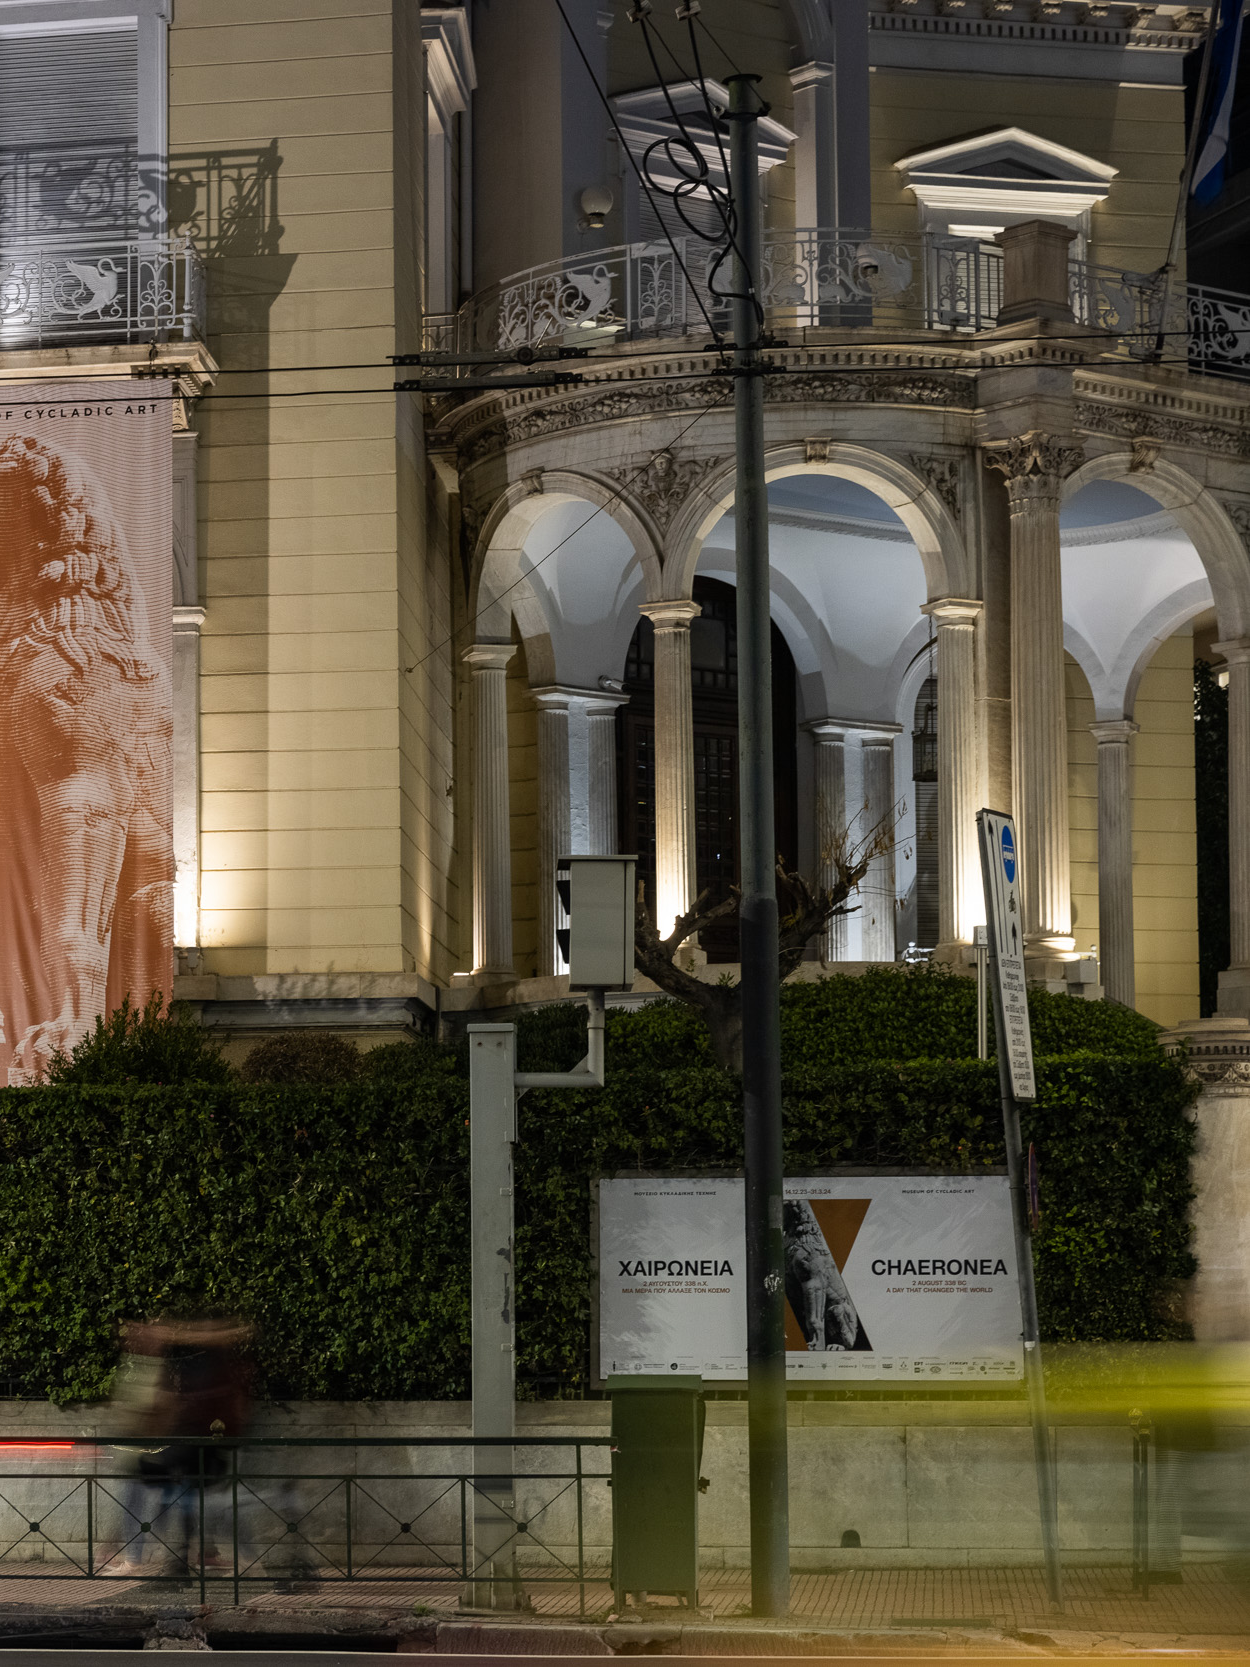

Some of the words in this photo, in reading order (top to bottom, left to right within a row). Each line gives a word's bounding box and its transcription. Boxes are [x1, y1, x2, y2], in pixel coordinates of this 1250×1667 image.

[24, 406, 113, 420] CYCLADIC
[125, 404, 158, 415] ART
[618, 1260, 734, 1276] ΧΑΙΡΩΝΕΙΑ
[871, 1259, 1008, 1276] CHAERONEA
